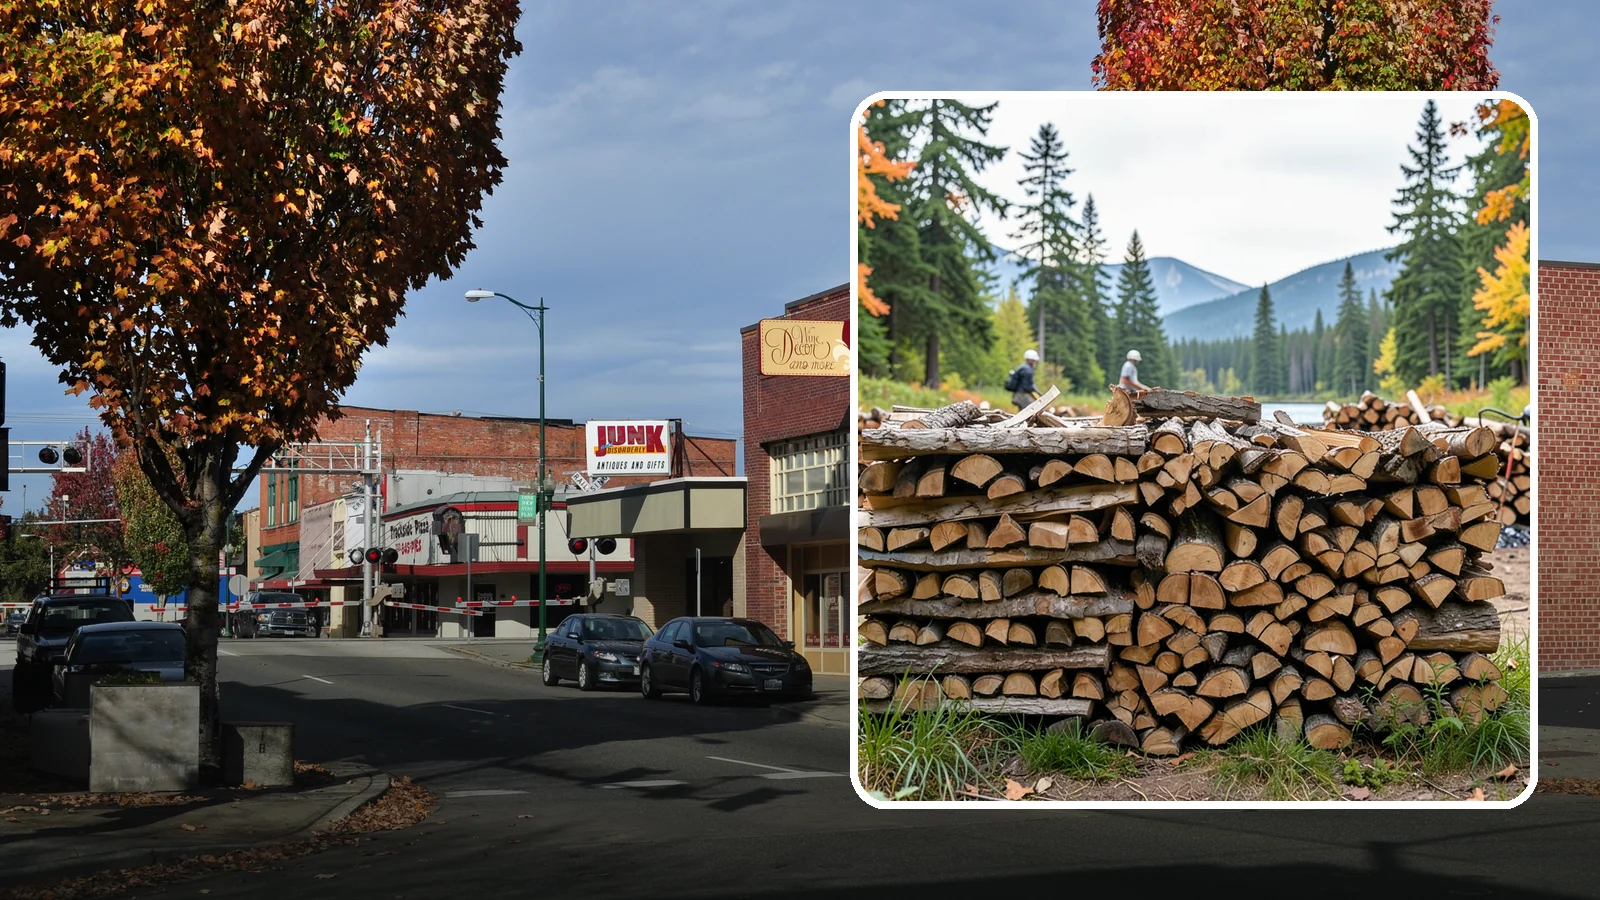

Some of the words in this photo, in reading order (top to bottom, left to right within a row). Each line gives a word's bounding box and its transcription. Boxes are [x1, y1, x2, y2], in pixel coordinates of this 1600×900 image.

[596, 425, 664, 457] JUNK
[607, 446, 645, 454] DISORDERLY
[596, 461, 628, 470] ANTIQUES
[631, 461, 644, 470] AND
[647, 460, 665, 469] GIFTS
[415, 519, 429, 535] Pizza
